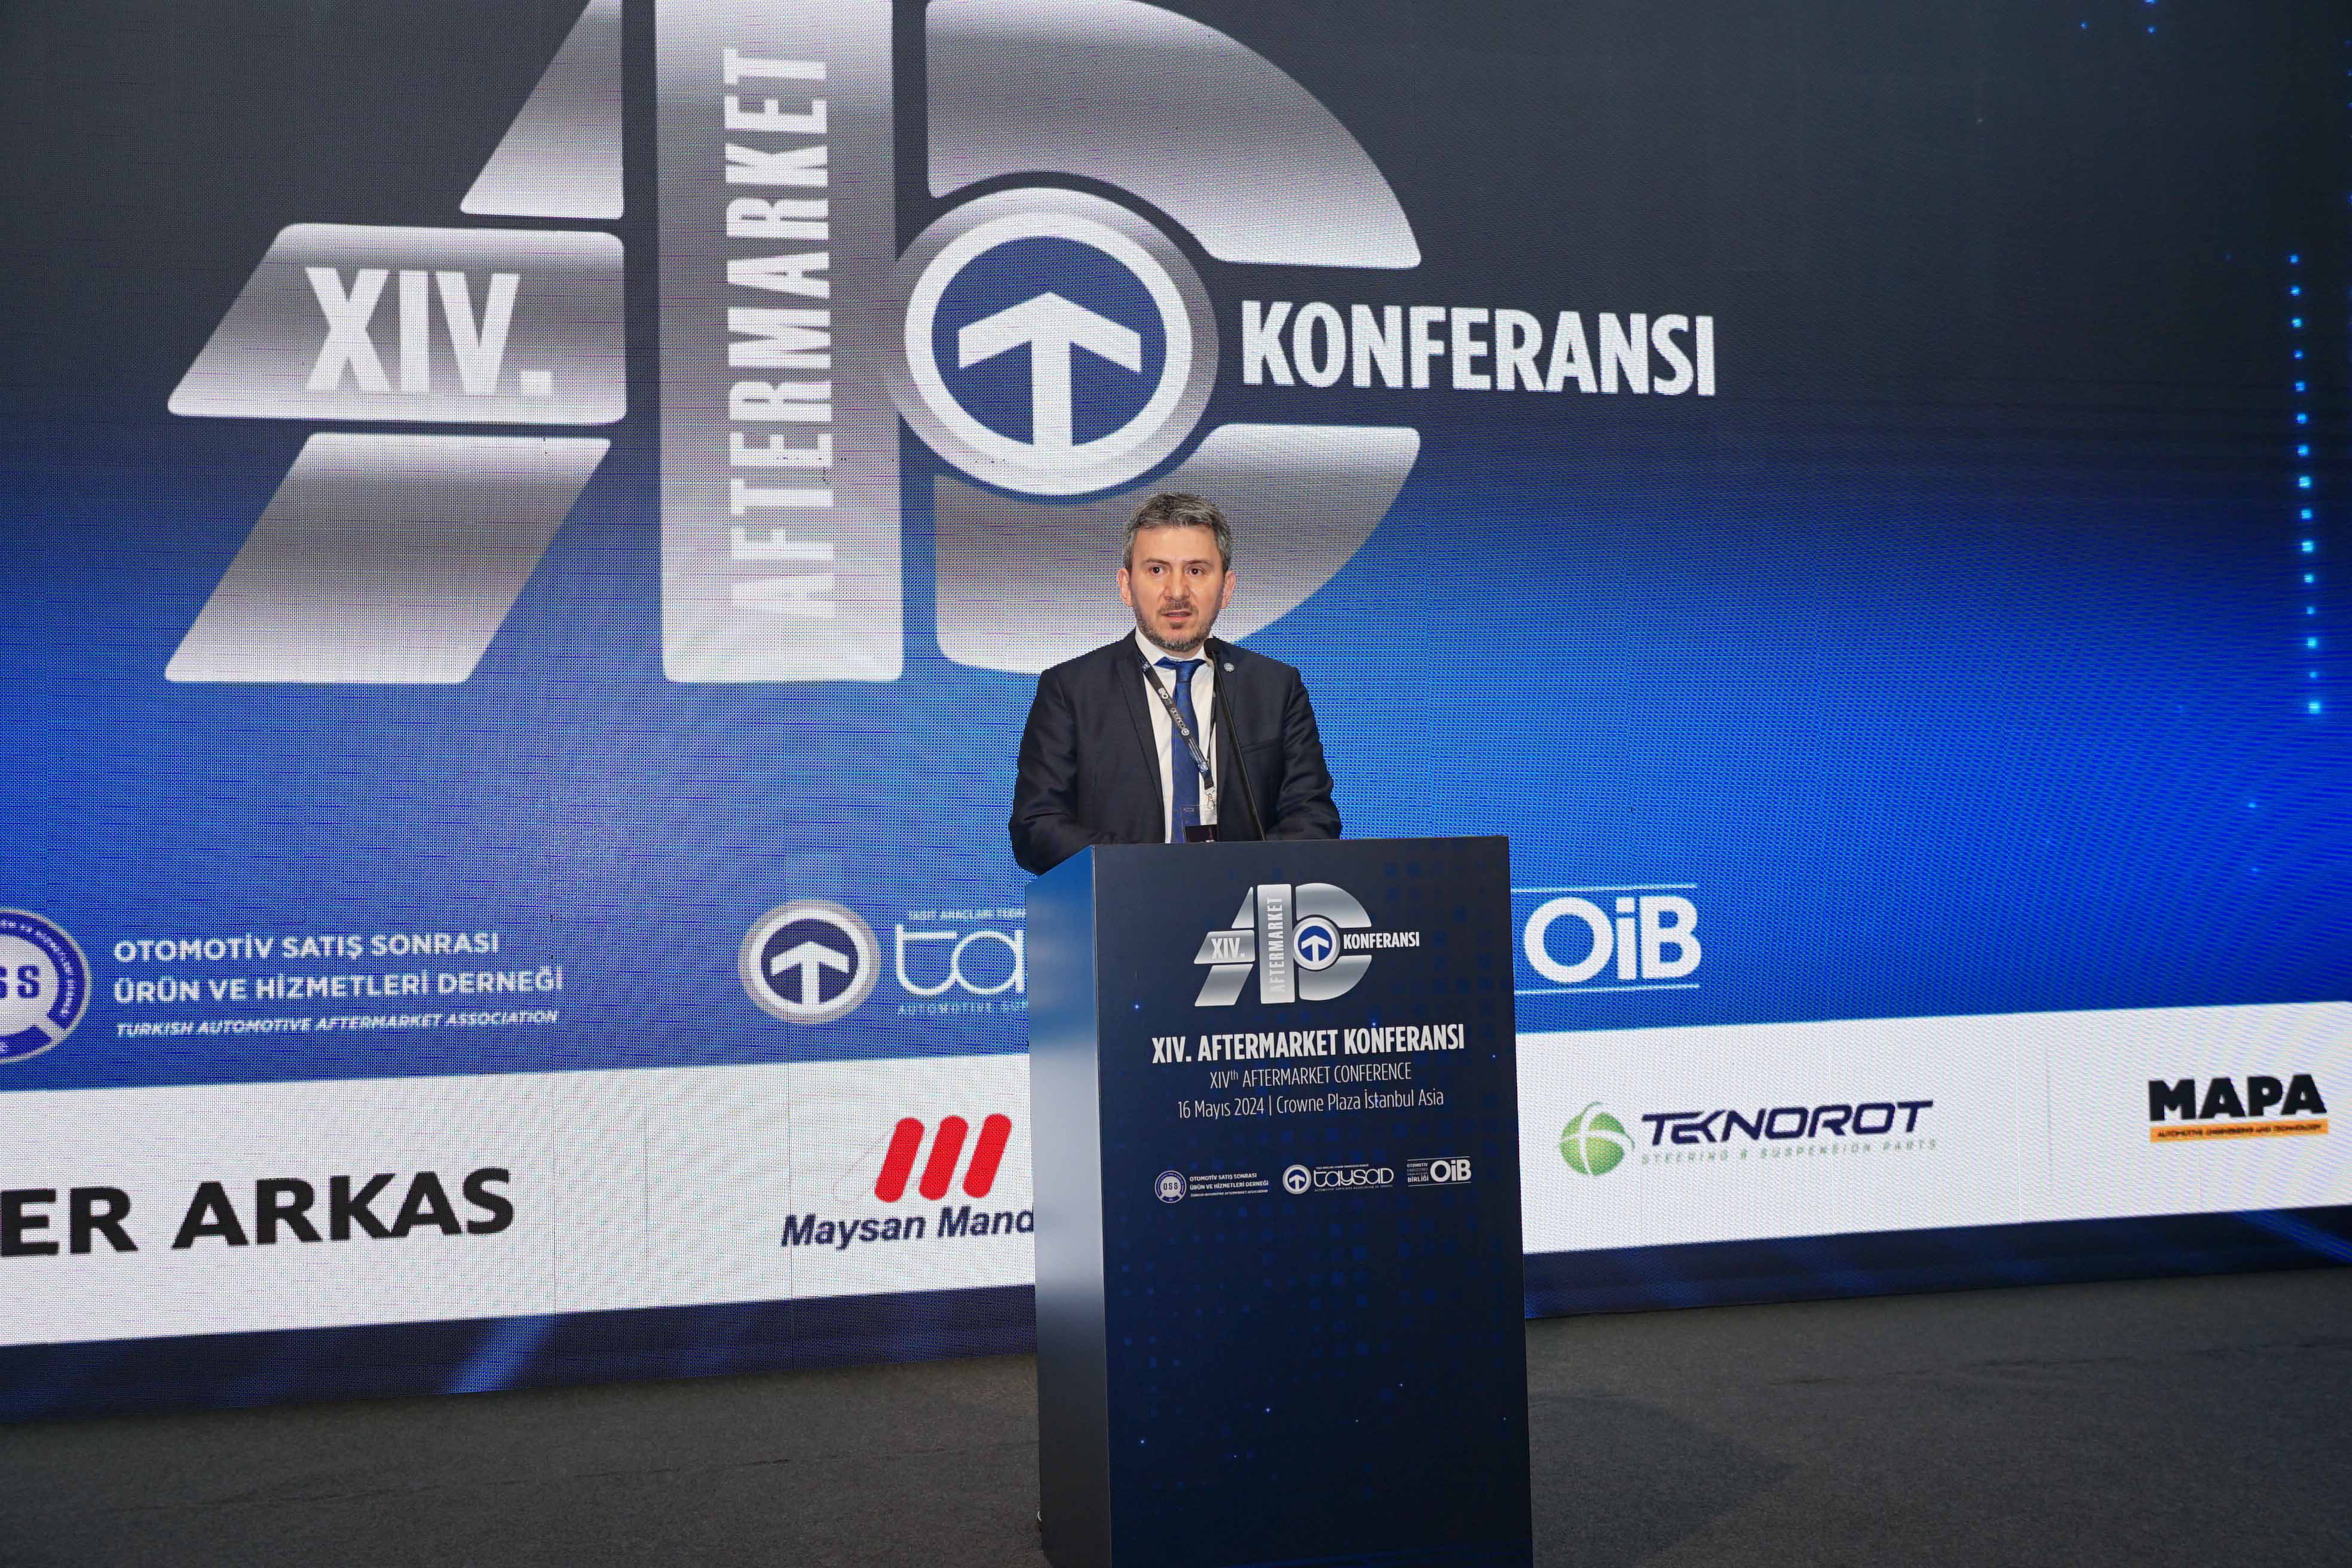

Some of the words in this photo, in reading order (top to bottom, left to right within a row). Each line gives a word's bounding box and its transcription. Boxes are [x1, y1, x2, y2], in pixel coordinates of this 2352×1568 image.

[304, 267, 552, 398] XIV.
[722, 48, 835, 617] AFTERMARKET
[1242, 299, 1716, 396] KONFERANSI
[114, 932, 273, 962] OTOMOTİV
[282, 935, 363, 959] SATIŞ
[370, 932, 498, 957] SONRASI
[1211, 938, 1245, 959] XIV.
[1267, 898, 1286, 993] AFTERMARKET
[1343, 932, 1420, 950] KONFERANSI
[115, 976, 200, 1003] ÜRÜN
[209, 979, 247, 1000] VE
[256, 969, 428, 1000] HİZMETLERİ
[439, 965, 563, 994] DERNEĞİ
[117, 1021, 194, 1037] TURKISH
[198, 1018, 312, 1034] AUTOMOTIVE
[315, 1013, 442, 1031] AFTERMARKET
[446, 1010, 559, 1027] ASSOCIATION
[1152, 1036, 1192, 1064] XIV.
[1198, 1030, 1338, 1061] AFTERMARKET
[1345, 1024, 1464, 1055] KONFERANSI
[1242, 1066, 1330, 1088] AFTERMARKET
[1334, 1062, 1412, 1083] CONFERENCE
[1178, 1101, 1190, 1119] 16
[1234, 1097, 1264, 1116] 2024
[1276, 1096, 1324, 1113] Crowne
[1328, 1093, 1361, 1110] Plaza
[1364, 1089, 1414, 1109] İstanbul
[1419, 1088, 1444, 1105] Asia
[2148, 1074, 2328, 1122] MAPA
[1642, 1100, 1934, 1146] TEKNOROT
[0, 1187, 139, 1257] ER
[172, 1168, 514, 1250] ARKAS
[781, 1214, 926, 1249] Maysan
